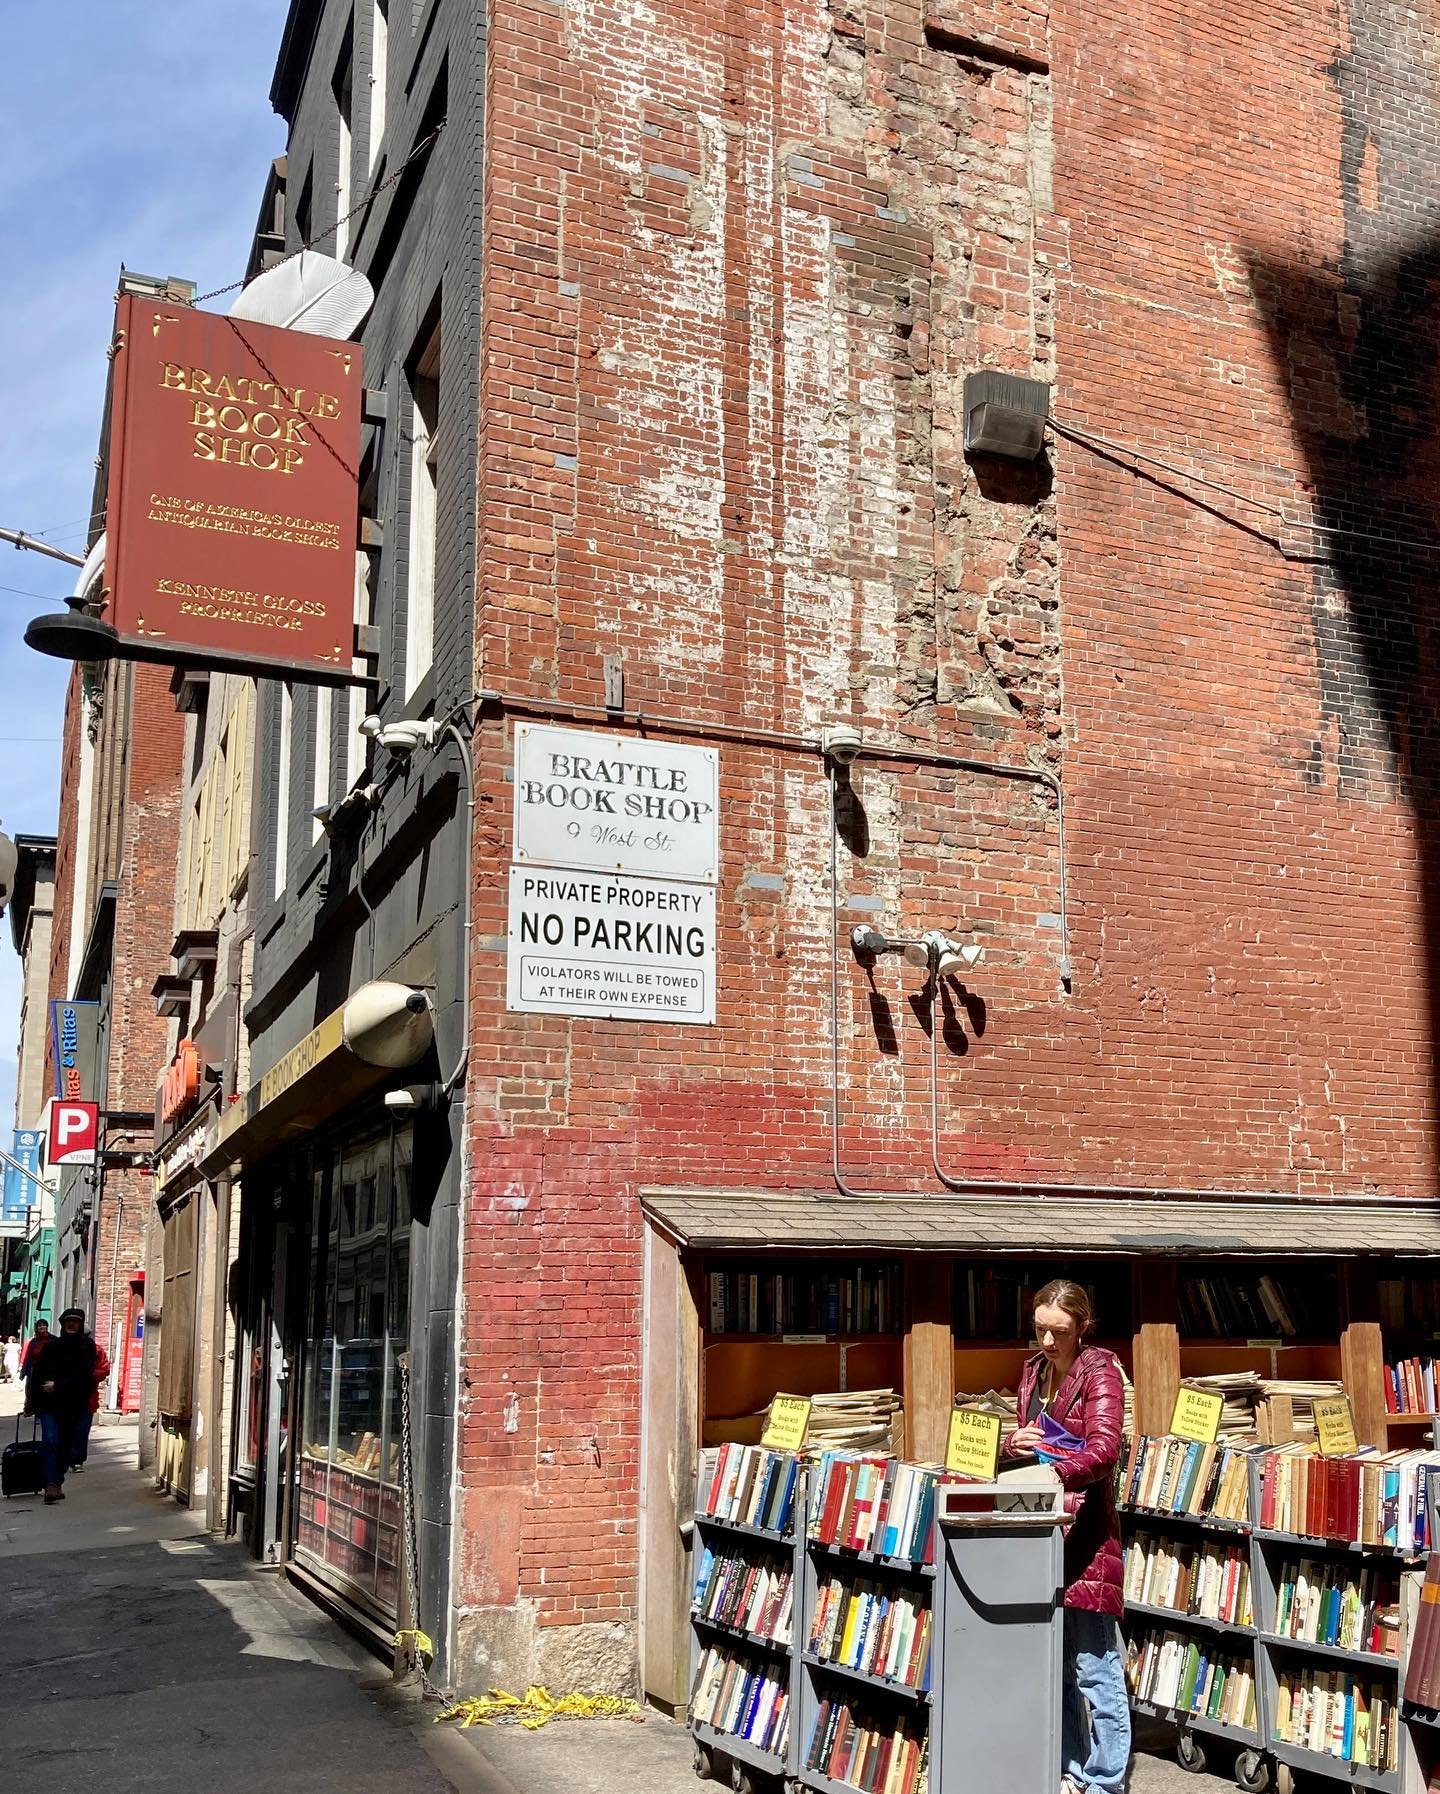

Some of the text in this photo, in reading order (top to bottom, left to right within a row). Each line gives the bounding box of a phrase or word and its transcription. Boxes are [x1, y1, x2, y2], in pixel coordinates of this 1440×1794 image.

[159, 361, 341, 419] BRATTLE
[188, 399, 311, 446] BOOK
[193, 432, 304, 474] SHOP
[147, 509, 340, 550] ANTIQUARIAN BOOK SHOPS
[149, 493, 182, 509] ONE
[184, 499, 205, 513] OF
[284, 515, 340, 536] OLDEST
[156, 579, 327, 617] KENNETH GLOSS
[179, 600, 304, 631] PROPRIETOR
[548, 752, 689, 793] BRATTLE
[523, 780, 712, 824] BOOK SHOP
[566, 821, 676, 853] 9 West St.
[524, 878, 702, 913] PRIVATE PROPERTY
[520, 911, 705, 958] NO PARKING
[527, 964, 698, 989] VIOLATORS WILL BE TOWED
[539, 986, 688, 1007] AT THEIR OWN EXPENSE
[295, 1029, 321, 1079] SHOP
[66, 1069, 80, 1101] itas
[58, 1108, 90, 1145] P
[1187, 1395, 1212, 1408] $5 Each
[959, 1433, 987, 1446] Books with
[960, 1412, 992, 1430] $5 Each
[955, 1443, 990, 1458] Yellow Sticker
